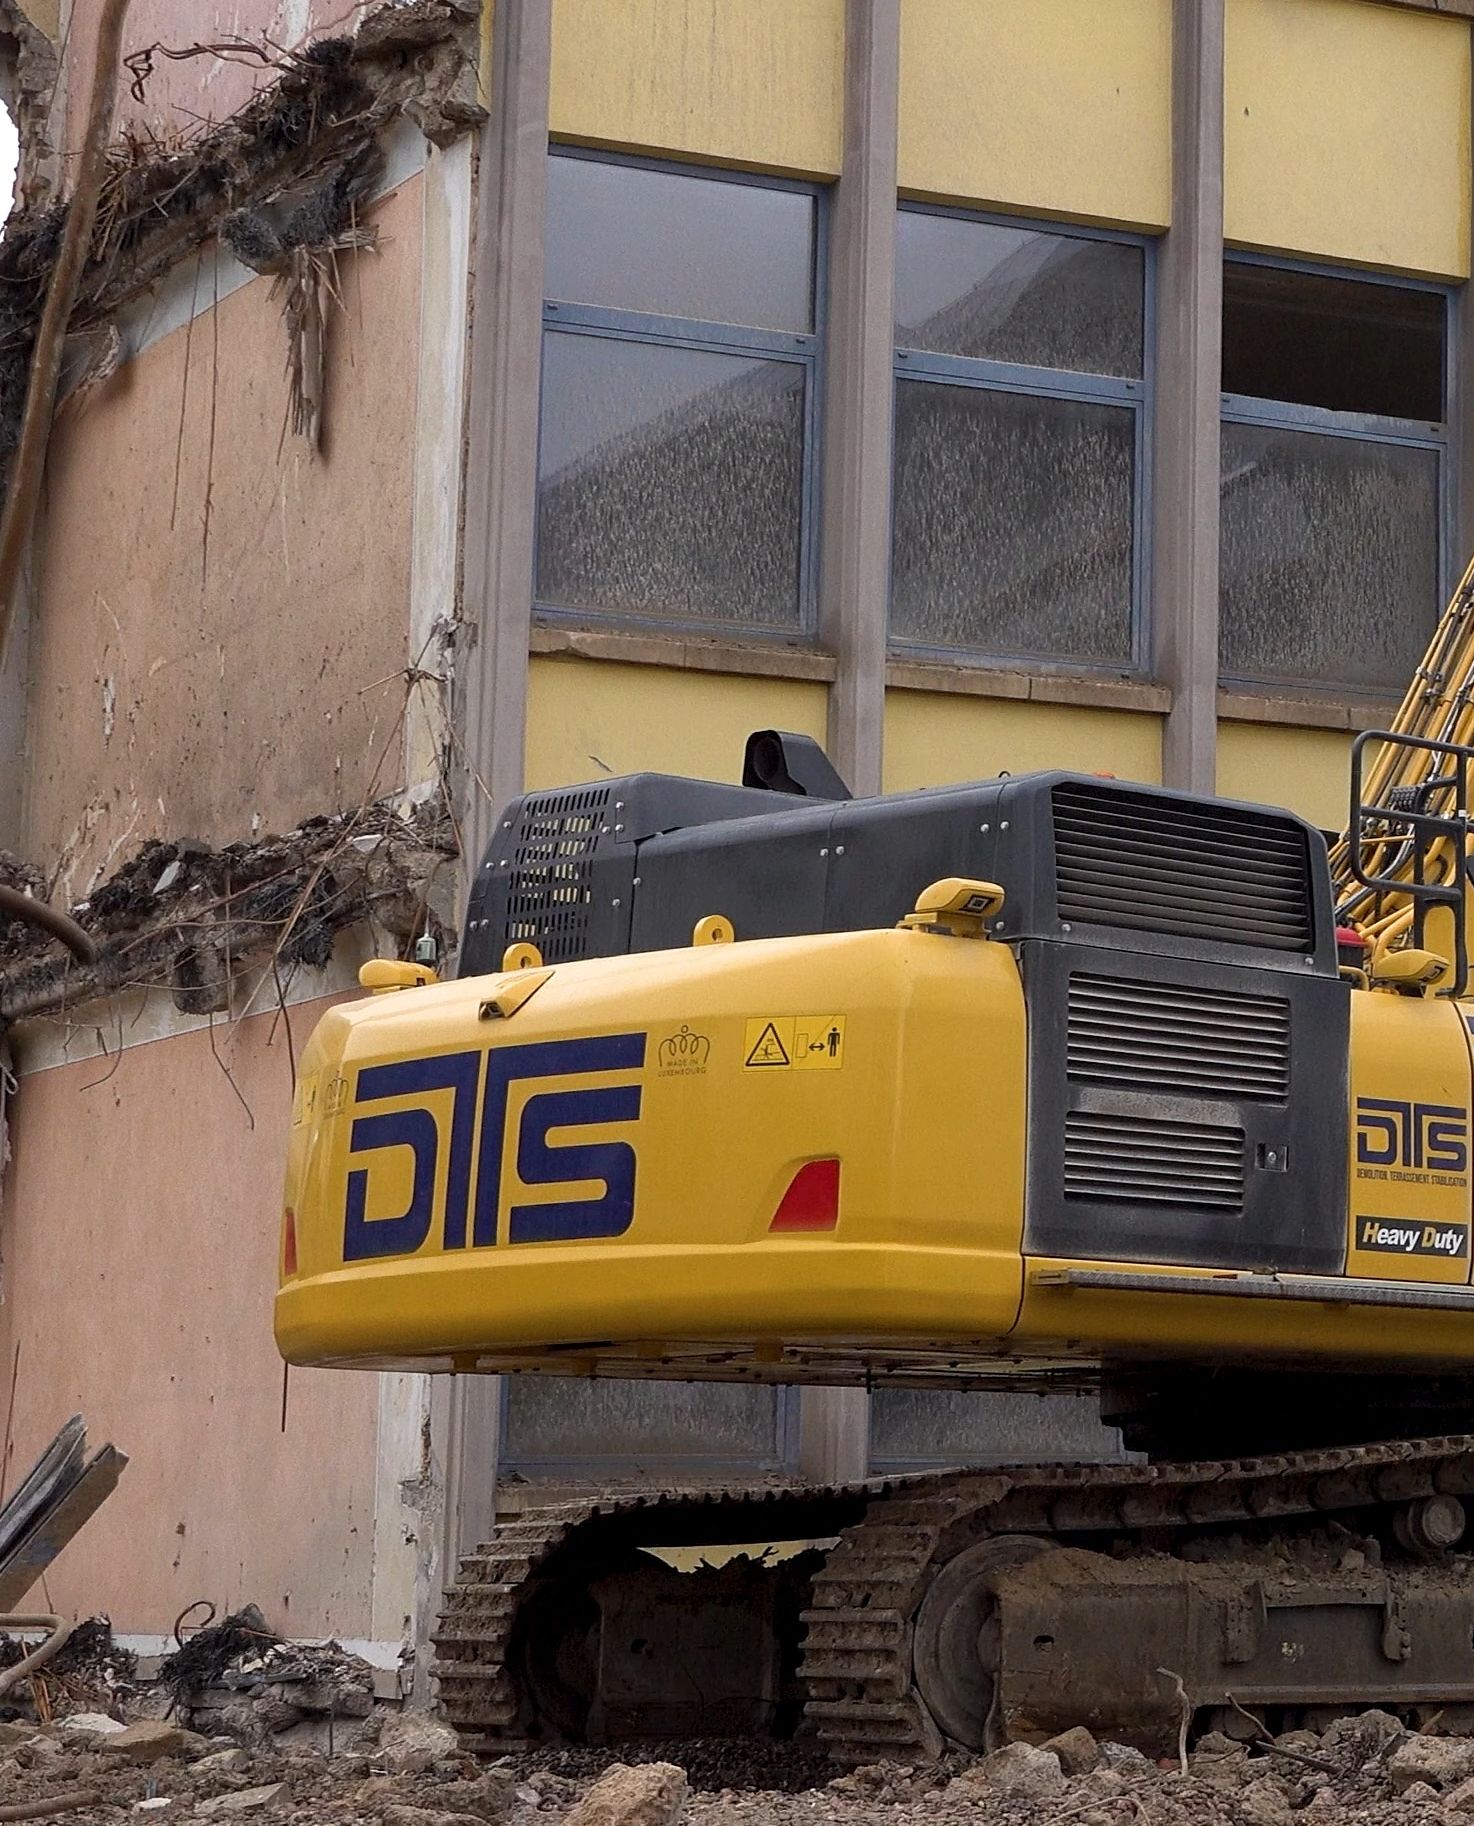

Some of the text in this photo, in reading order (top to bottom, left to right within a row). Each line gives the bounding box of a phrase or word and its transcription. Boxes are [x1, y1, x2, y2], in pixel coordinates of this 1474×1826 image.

[343, 1032, 646, 1262] DTS
[1357, 1097, 1467, 1172] DTS
[1362, 1222, 1464, 1256] Heavy Duty
